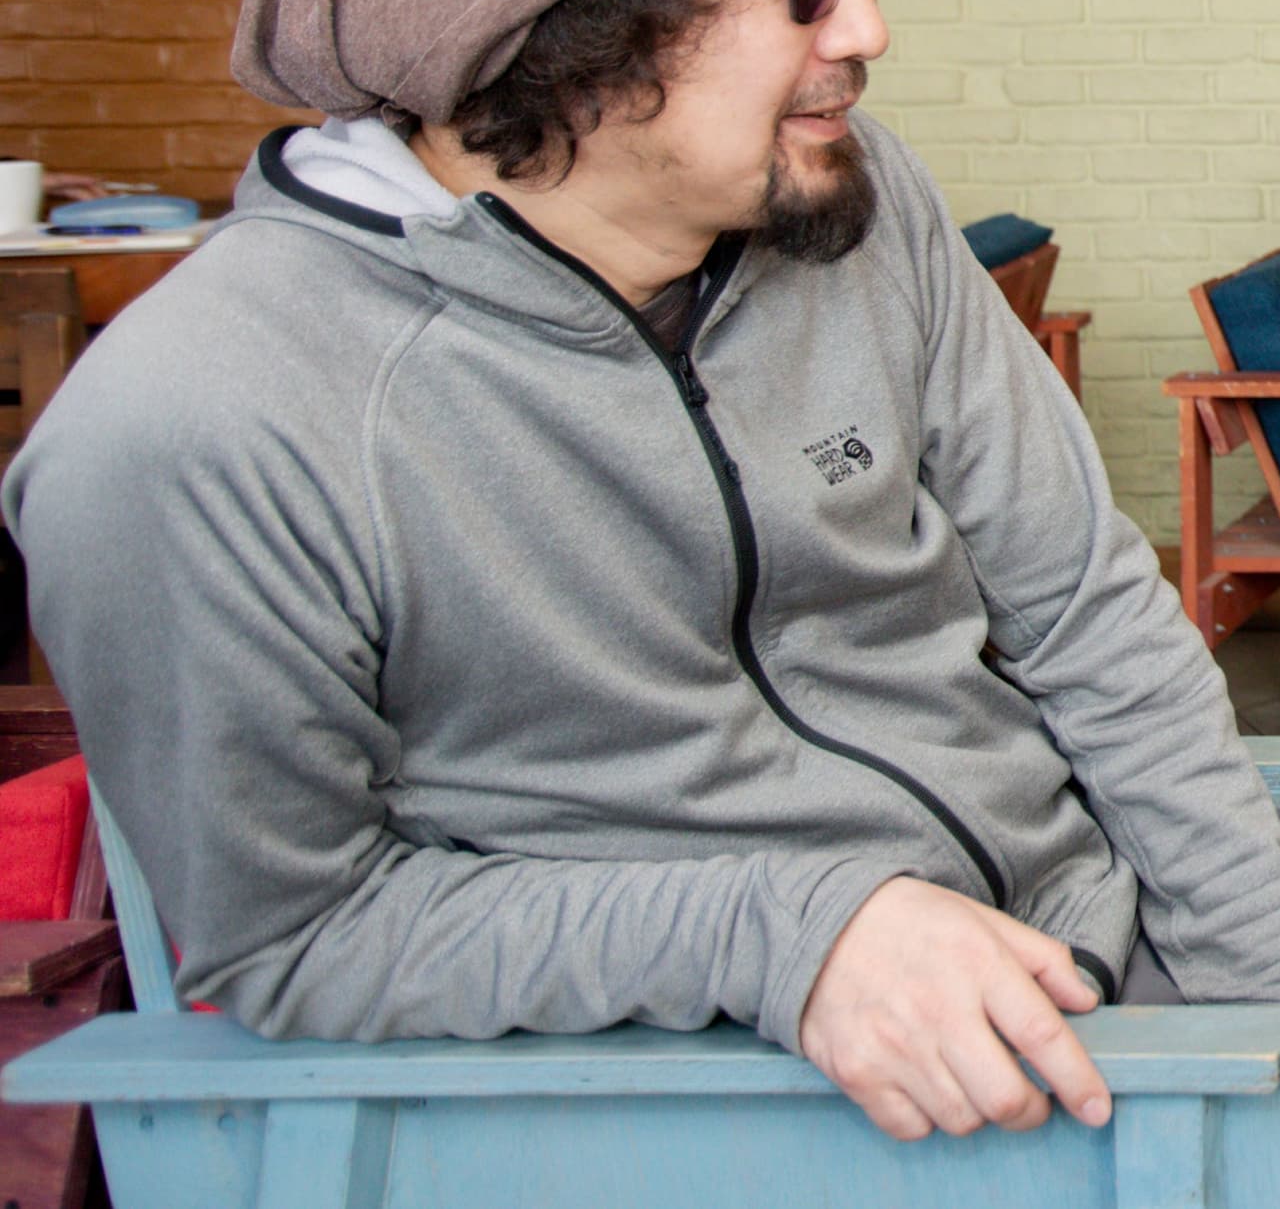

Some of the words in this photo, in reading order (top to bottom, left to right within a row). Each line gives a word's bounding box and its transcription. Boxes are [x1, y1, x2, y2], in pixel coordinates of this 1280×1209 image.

[802, 424, 859, 454] MOUNTAIN
[810, 448, 845, 472] HARD
[821, 461, 857, 486] WEAR
